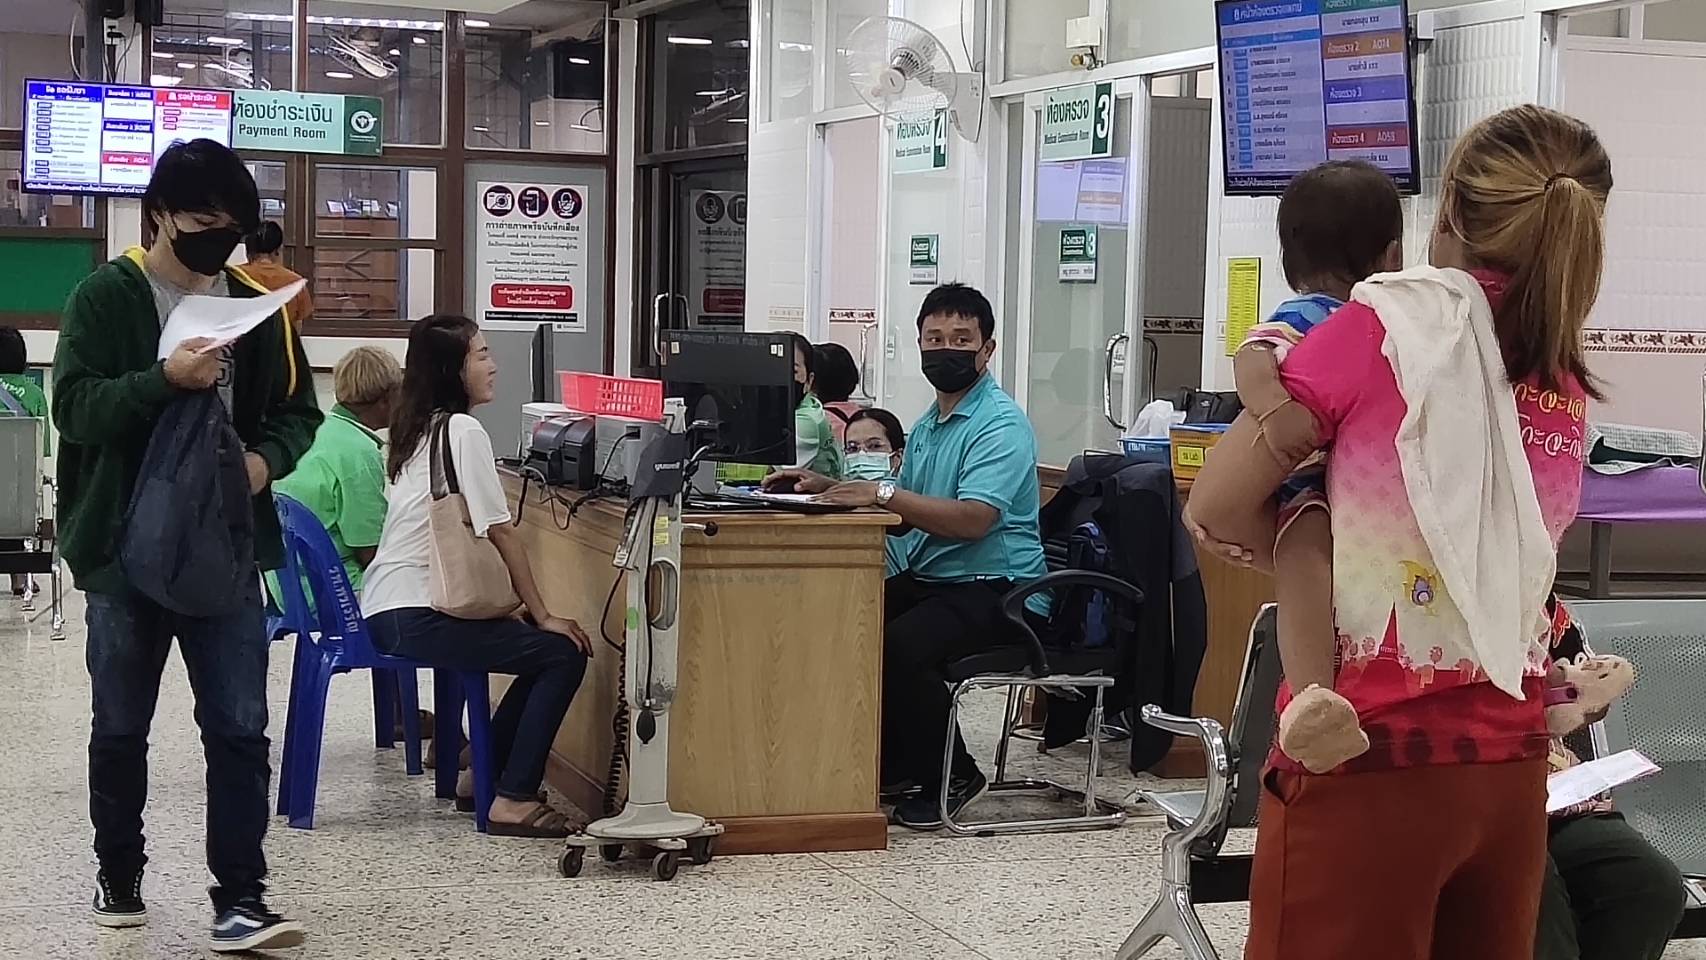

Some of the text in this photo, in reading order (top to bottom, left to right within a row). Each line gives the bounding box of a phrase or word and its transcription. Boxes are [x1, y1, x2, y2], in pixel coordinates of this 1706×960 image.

[233, 96, 333, 123] ห้องชำระเงิน
[1046, 94, 1110, 139] ห้องตรวจ 3
[239, 123, 326, 139] Payment Room
[935, 112, 946, 154] 4
[1088, 232, 1096, 255] 3
